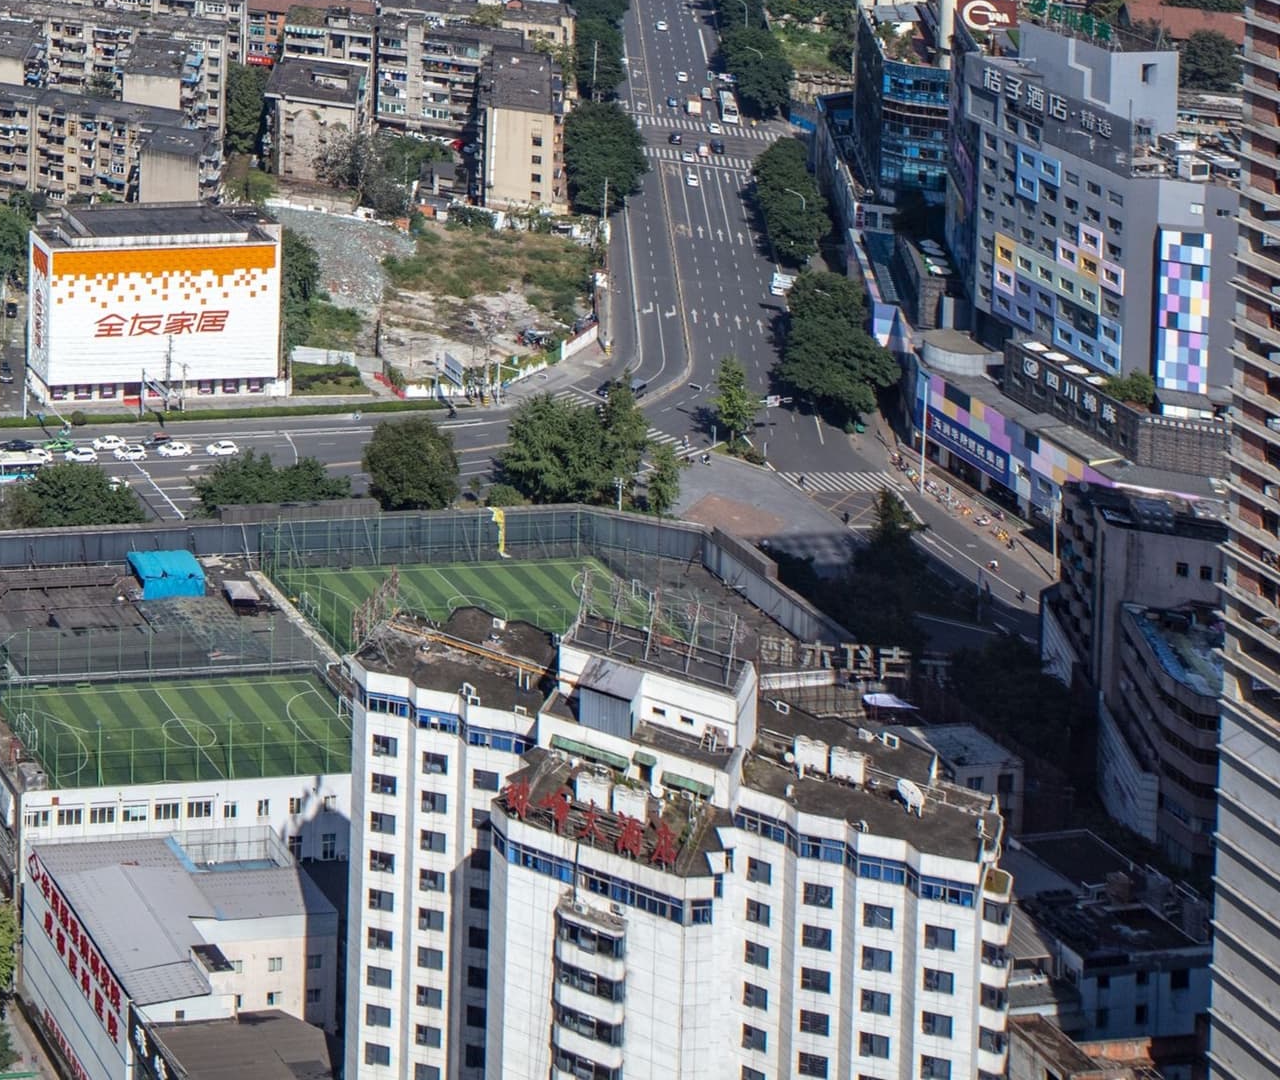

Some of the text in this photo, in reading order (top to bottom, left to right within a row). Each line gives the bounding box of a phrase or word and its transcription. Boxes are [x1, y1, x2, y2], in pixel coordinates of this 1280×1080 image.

[94, 310, 229, 338] 全友家居
[1046, 370, 1117, 424] 四川棉麻
